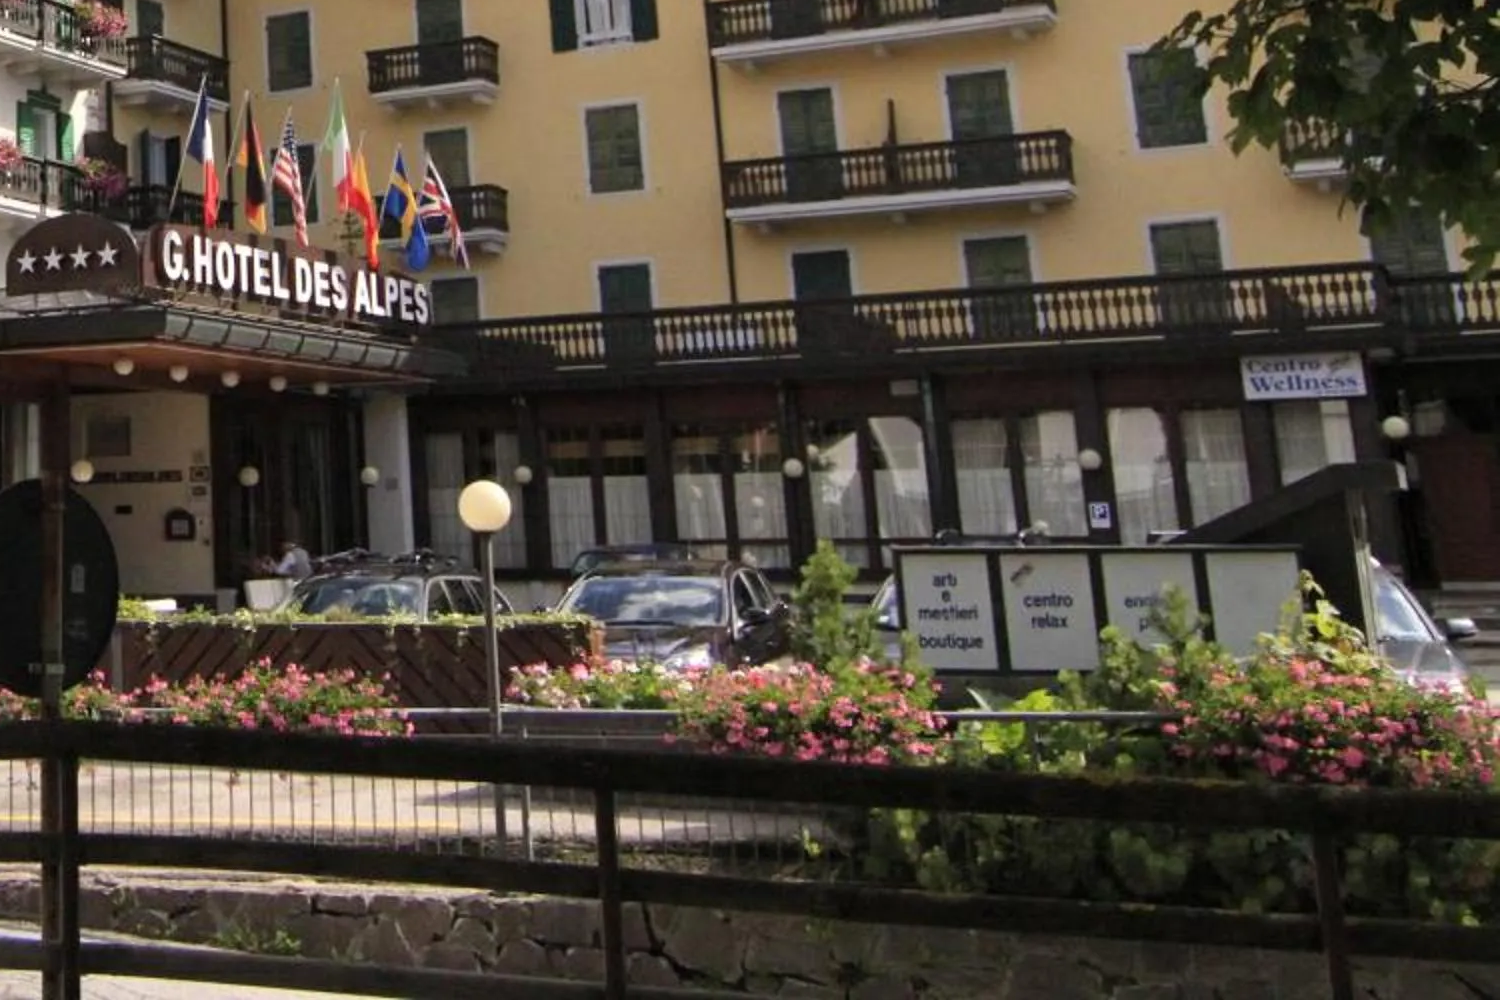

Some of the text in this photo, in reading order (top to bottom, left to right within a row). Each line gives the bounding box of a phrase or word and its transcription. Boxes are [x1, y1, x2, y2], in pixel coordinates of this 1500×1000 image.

[193, 234, 291, 300] HOTEL
[294, 257, 348, 311] DES
[353, 268, 430, 326] ALPES
[1247, 358, 1322, 373] Centro
[1249, 374, 1358, 393] Wellness
[1022, 591, 1073, 608] centro
[918, 604, 979, 621] mestieri
[1030, 612, 1069, 630] relax
[918, 633, 984, 653] boutique
